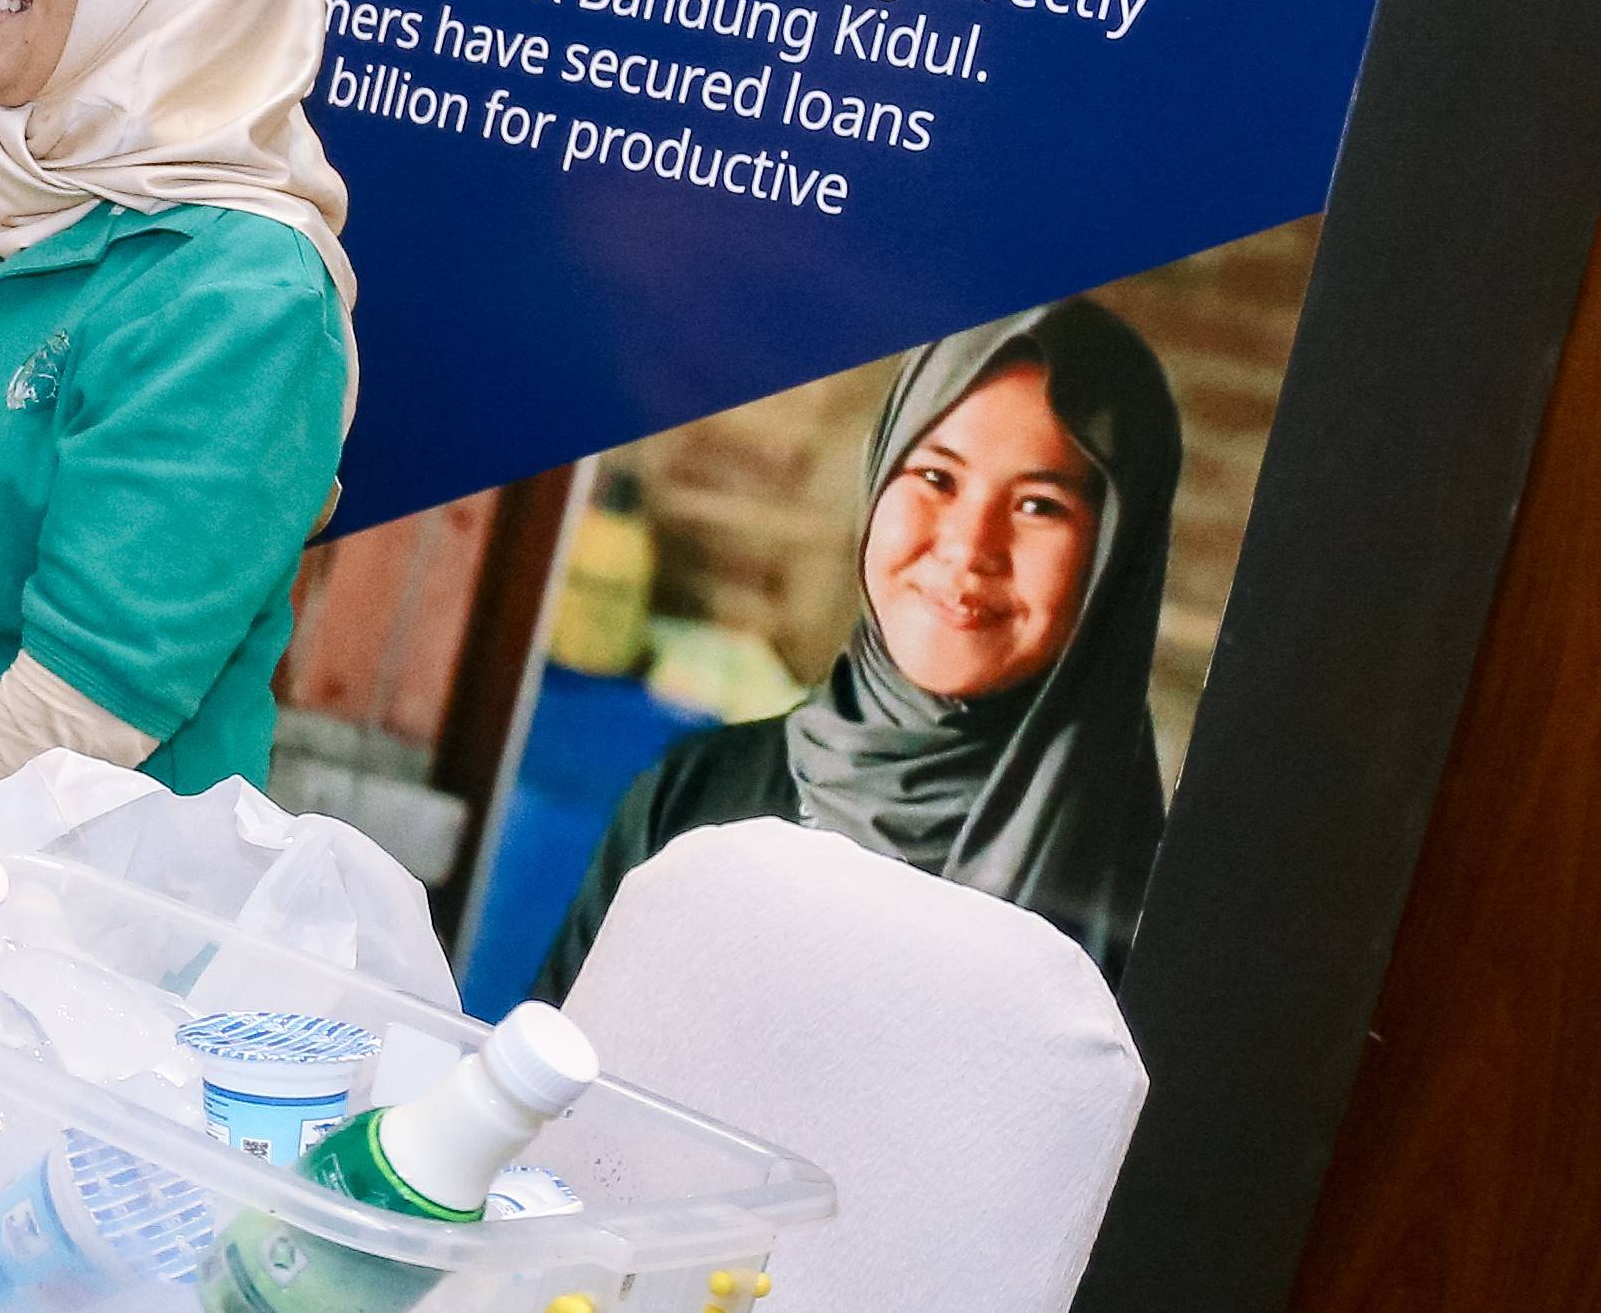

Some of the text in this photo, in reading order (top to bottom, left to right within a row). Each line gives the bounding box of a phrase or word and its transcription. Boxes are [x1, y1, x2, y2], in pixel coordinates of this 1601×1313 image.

[432, 3, 550, 75] have
[561, 42, 773, 119] secured
[781, 70, 935, 152] loans
[832, 3, 989, 84] Kidul.
[326, 55, 849, 216] billion for productive
